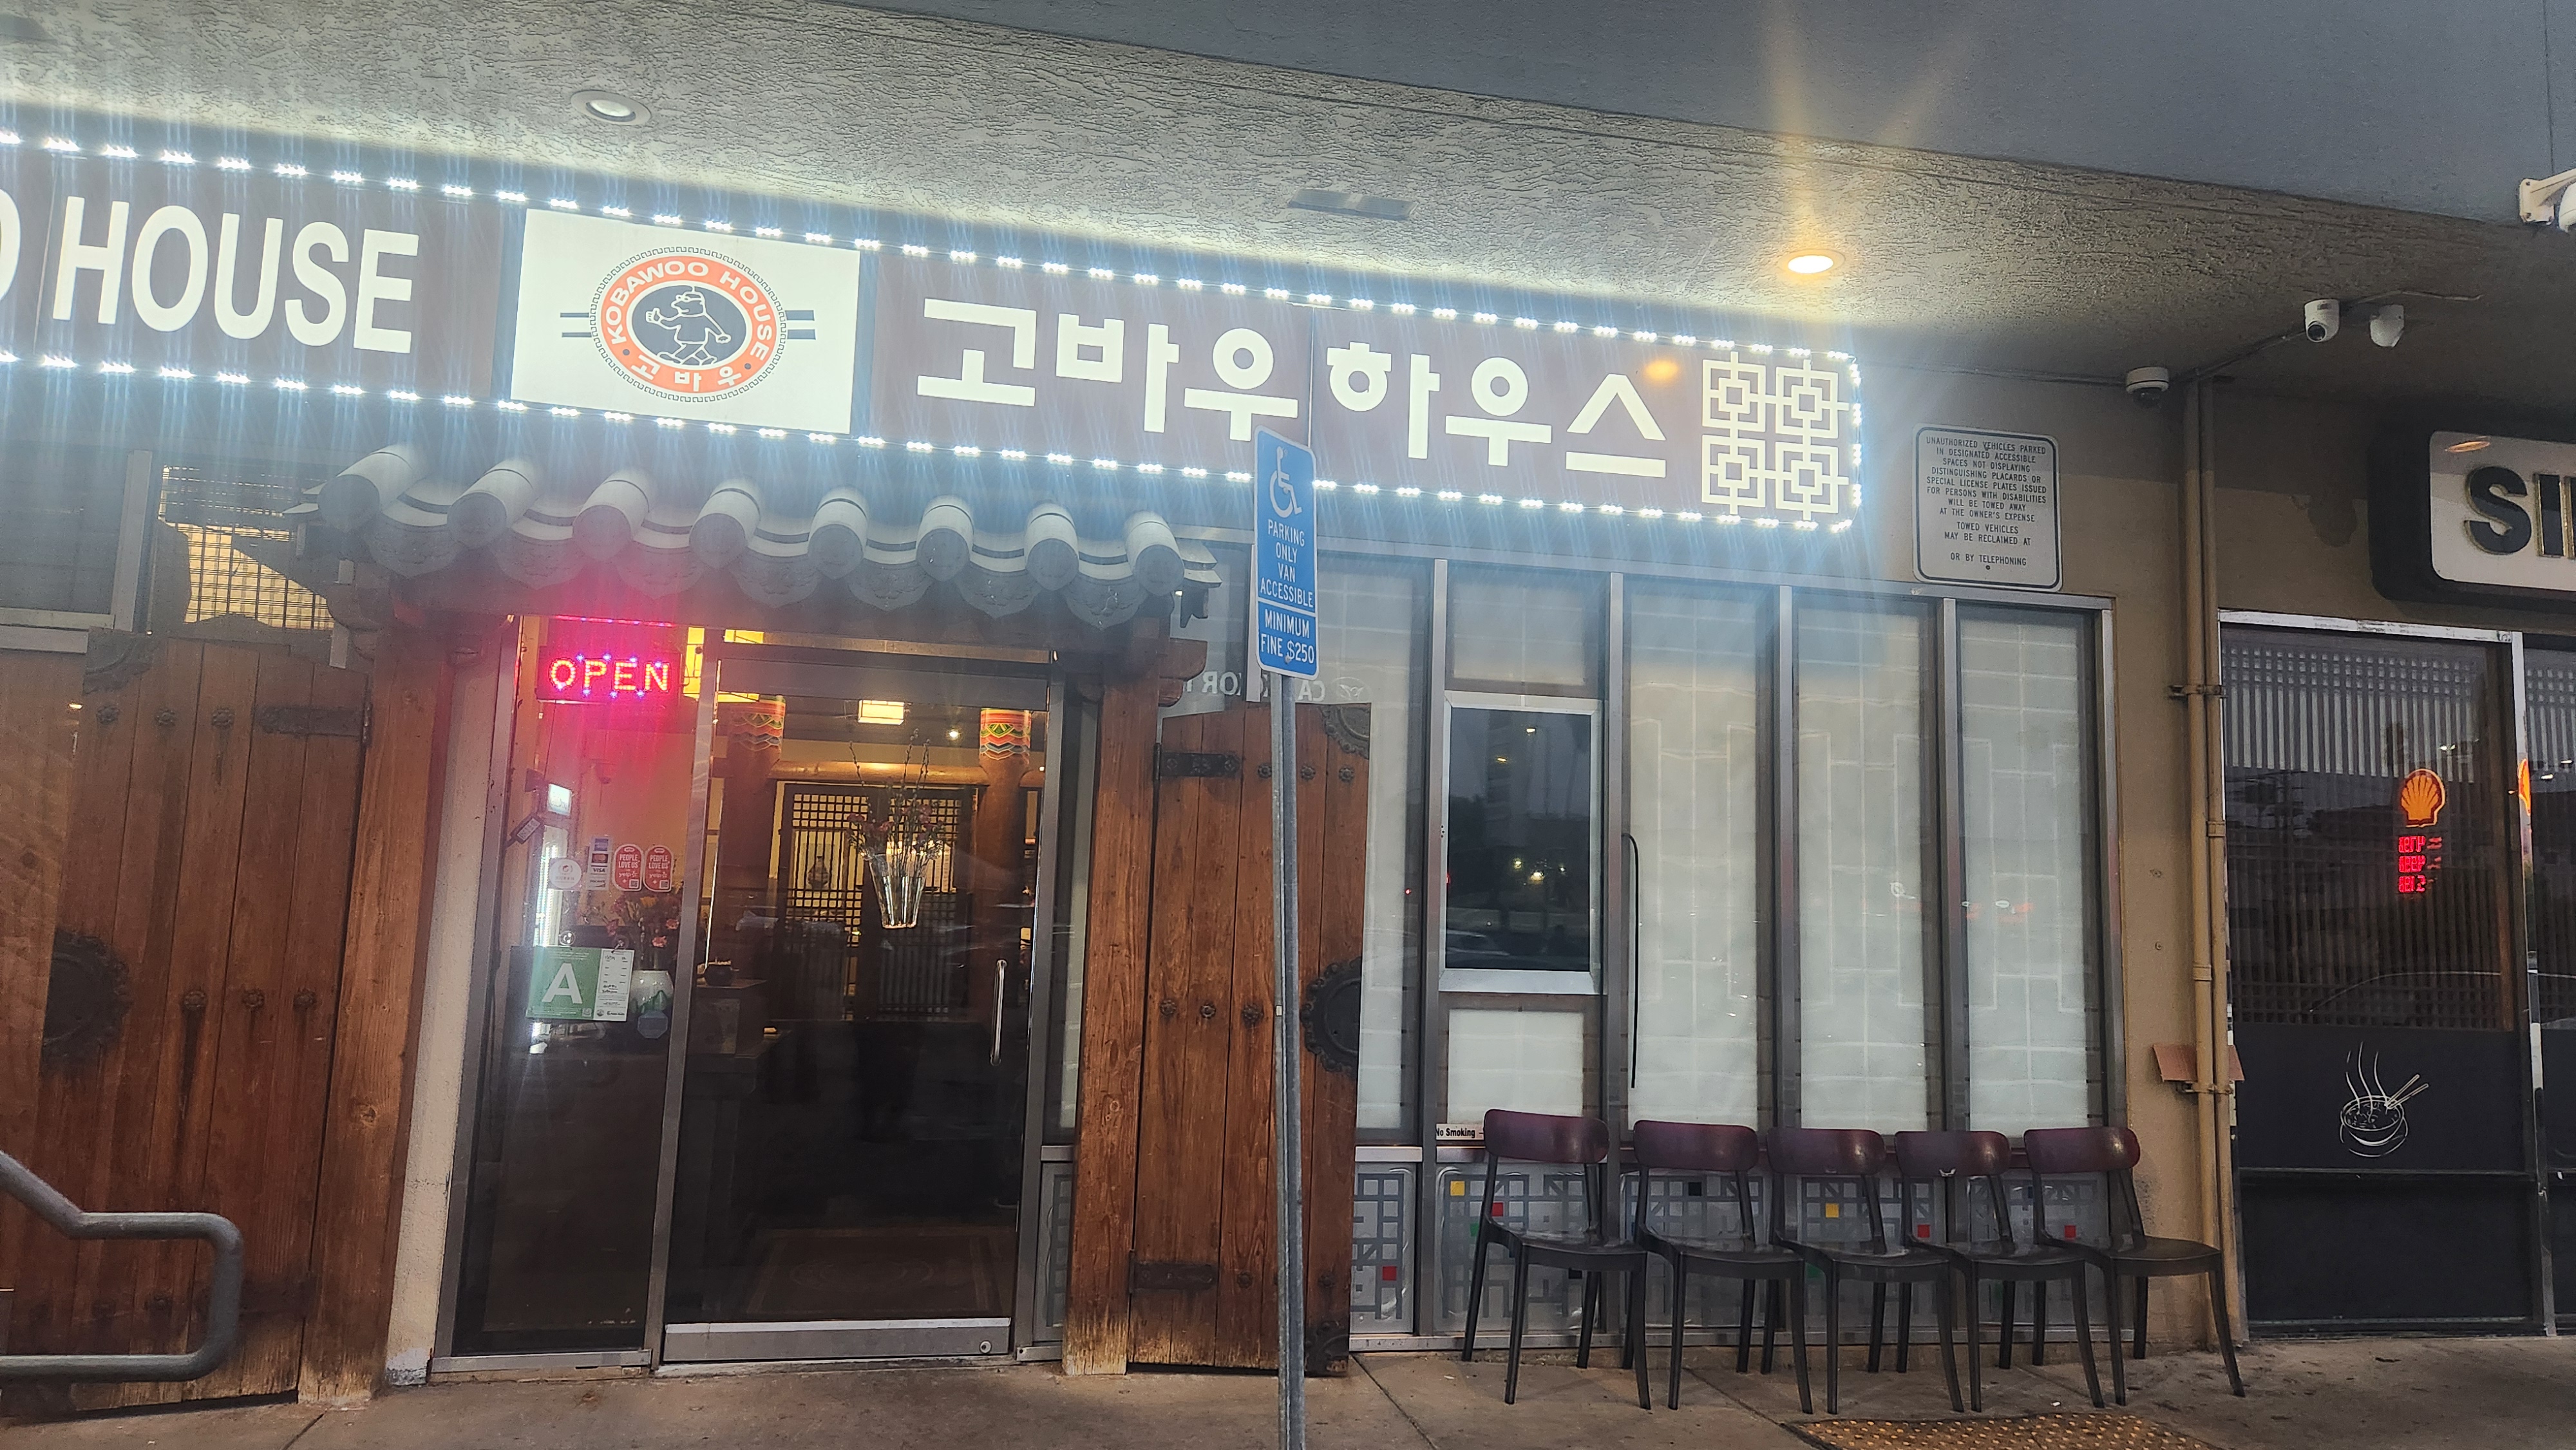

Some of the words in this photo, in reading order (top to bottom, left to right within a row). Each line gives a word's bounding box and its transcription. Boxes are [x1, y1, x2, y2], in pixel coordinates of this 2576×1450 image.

[53, 196, 419, 353] HOUSE
[607, 261, 709, 344] KOBAWOO
[719, 270, 773, 361] HOUSE
[630, 354, 741, 392] 고바우
[1926, 437, 1978, 447] UNAUTHORIZED
[1983, 442, 2015, 451] VEHICLES
[2020, 445, 2046, 454] PARKED
[1949, 448, 1989, 459] DESIGNATED
[1995, 453, 2036, 463] ACCESSIBLE
[1943, 458, 1967, 467] SPACES
[1991, 462, 2030, 473] DISPLAYING
[1932, 467, 1987, 478] DISTINGUISHING
[1992, 472, 2027, 482] PLACARDS
[1927, 476, 1955, 485] SPECIAL
[1960, 480, 1988, 489] LICENSE
[1993, 482, 2017, 491] PLATES
[2022, 485, 2047, 493] ISSUED
[1946, 489, 1976, 498] PERSONS
[2003, 493, 2046, 503] DISABILITIES
[1982, 501, 2004, 509] TOWED
[2009, 504, 2026, 512] AWAY
[2464, 466, 2576, 560] SI
[1969, 510, 2000, 519] OWNER'S
[2005, 513, 2035, 522] EXPENSE
[1268, 519, 1305, 547] PARKING
[1957, 522, 1980, 531] TOWED
[1985, 524, 2018, 534] VEHICLES
[1979, 534, 2018, 545] RECLAIMED
[1276, 545, 1298, 563] ONLY
[1965, 554, 1974, 562] BY
[1980, 554, 2026, 566] TELEPHONING
[1278, 564, 1295, 583] VAN
[1260, 578, 1313, 608] ACCESSIBLE
[1265, 608, 1309, 639] MINIMUM
[1260, 634, 1283, 657] FINE
[1287, 641, 1314, 664] $250
[549, 657, 670, 692] OPEN
[542, 963, 583, 1004] A
[1446, 1127, 1475, 1138] Smoking
